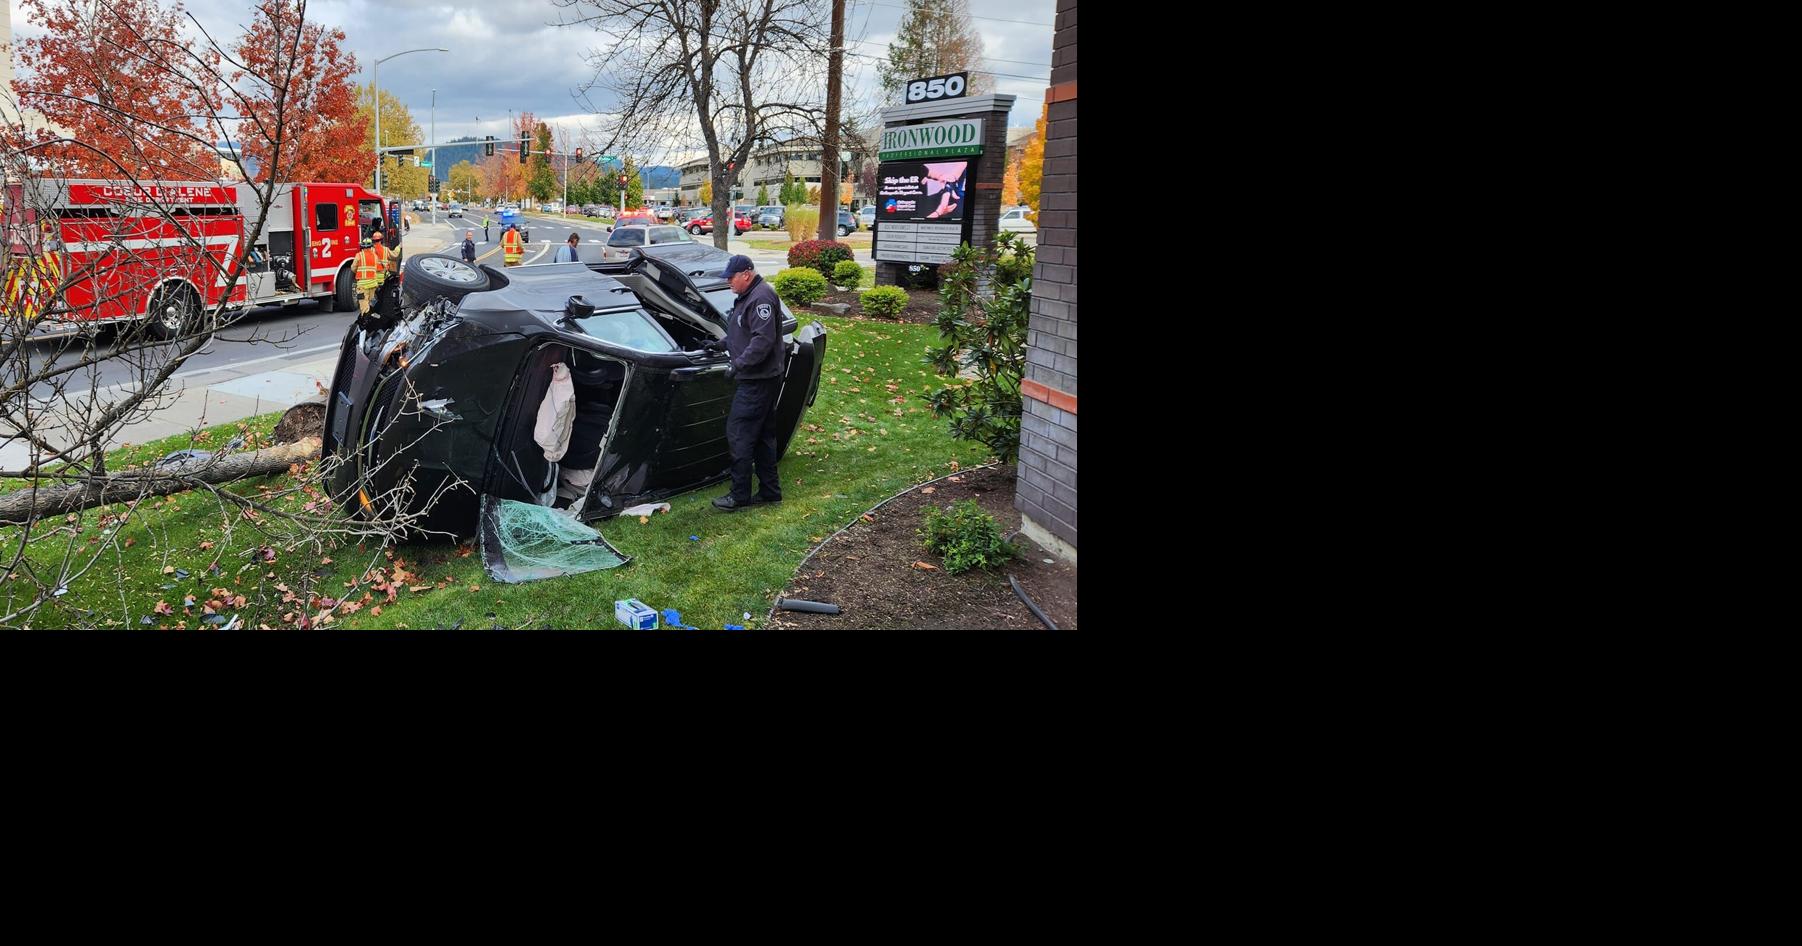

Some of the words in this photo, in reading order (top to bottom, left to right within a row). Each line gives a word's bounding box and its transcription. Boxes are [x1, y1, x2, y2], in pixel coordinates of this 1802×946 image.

[908, 76, 964, 101] 850
[883, 123, 976, 150] IRONWOOD
[882, 148, 941, 158] PROFESSIONAL
[884, 176, 898, 185] Skip
[898, 176, 909, 184] the
[909, 175, 919, 184] ER
[321, 237, 332, 258] 2
